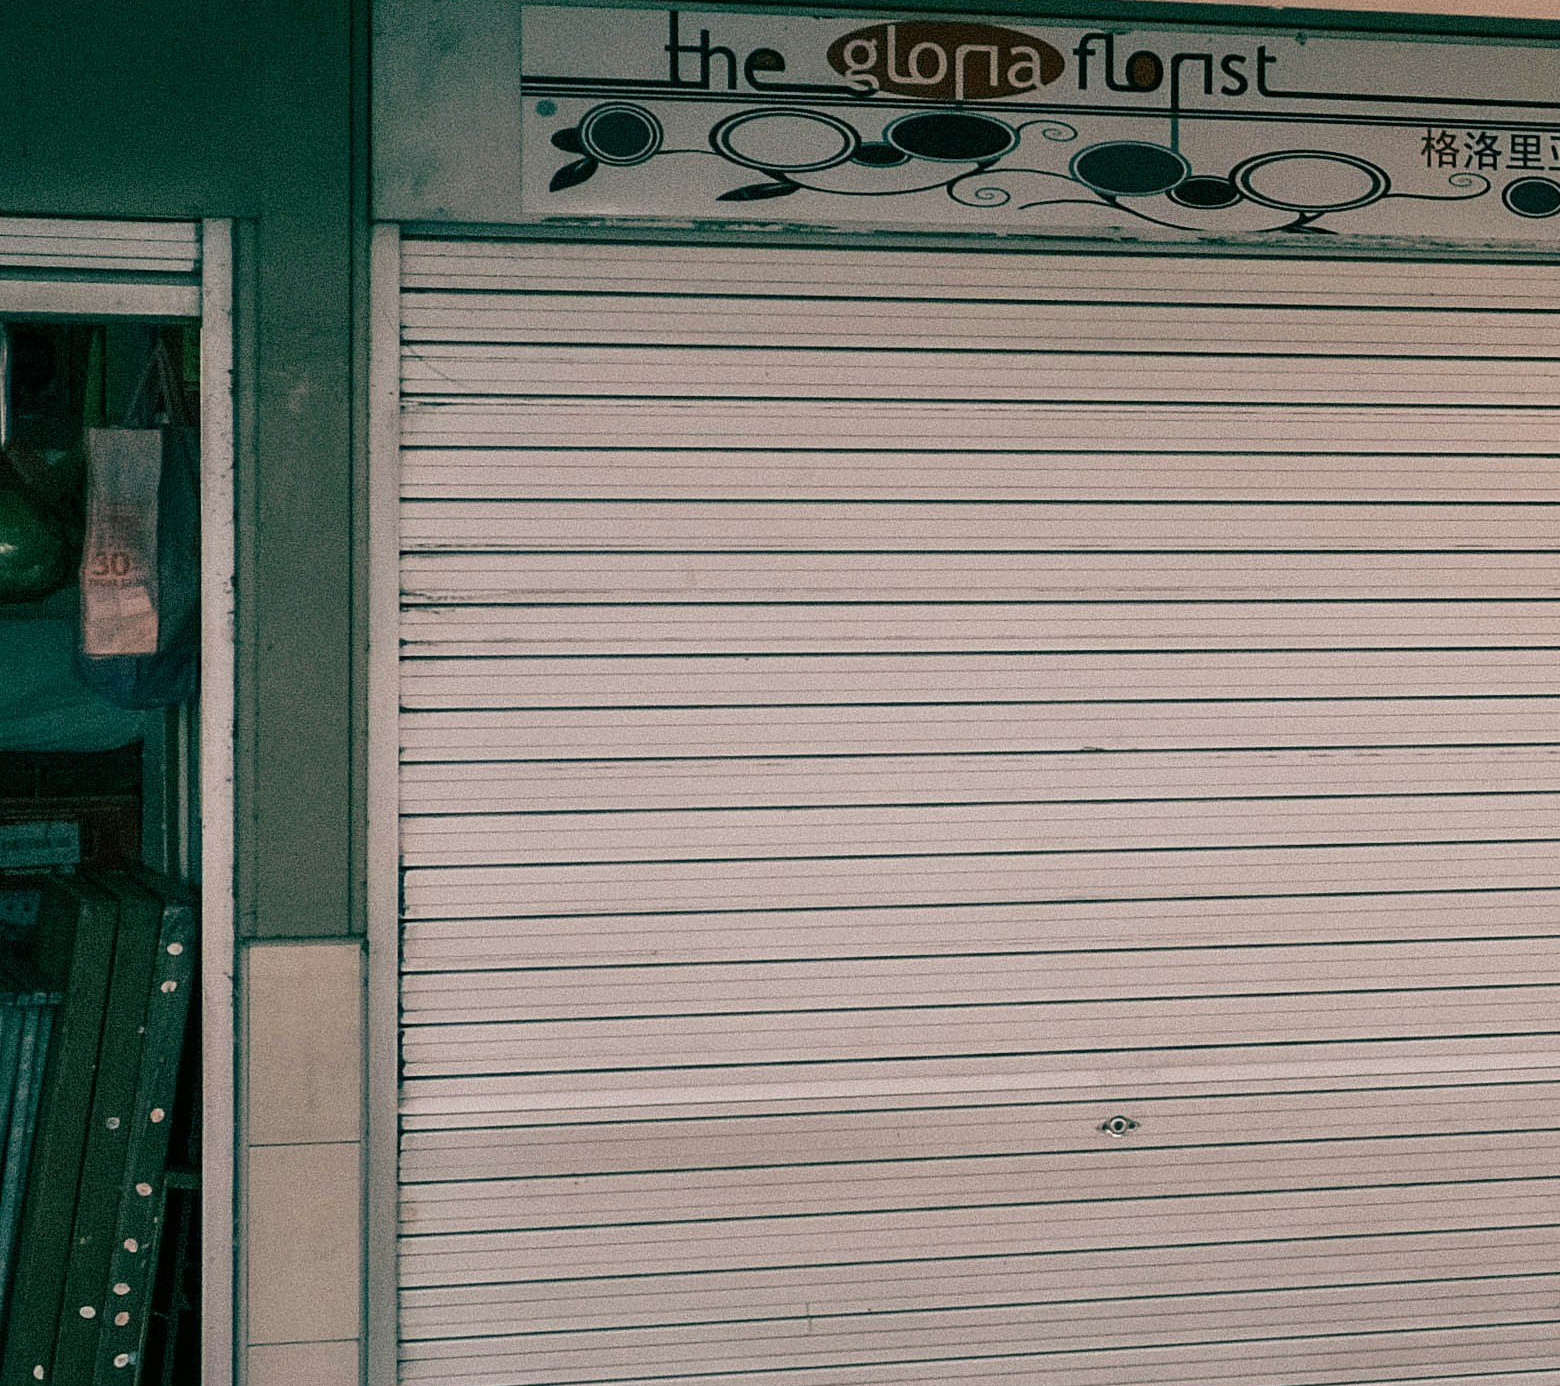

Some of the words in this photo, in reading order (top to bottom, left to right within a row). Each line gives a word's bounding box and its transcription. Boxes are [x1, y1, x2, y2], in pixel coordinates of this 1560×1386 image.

[664, 11, 786, 90] the
[842, 24, 1050, 101] gloria
[1071, 31, 1278, 103] florist
